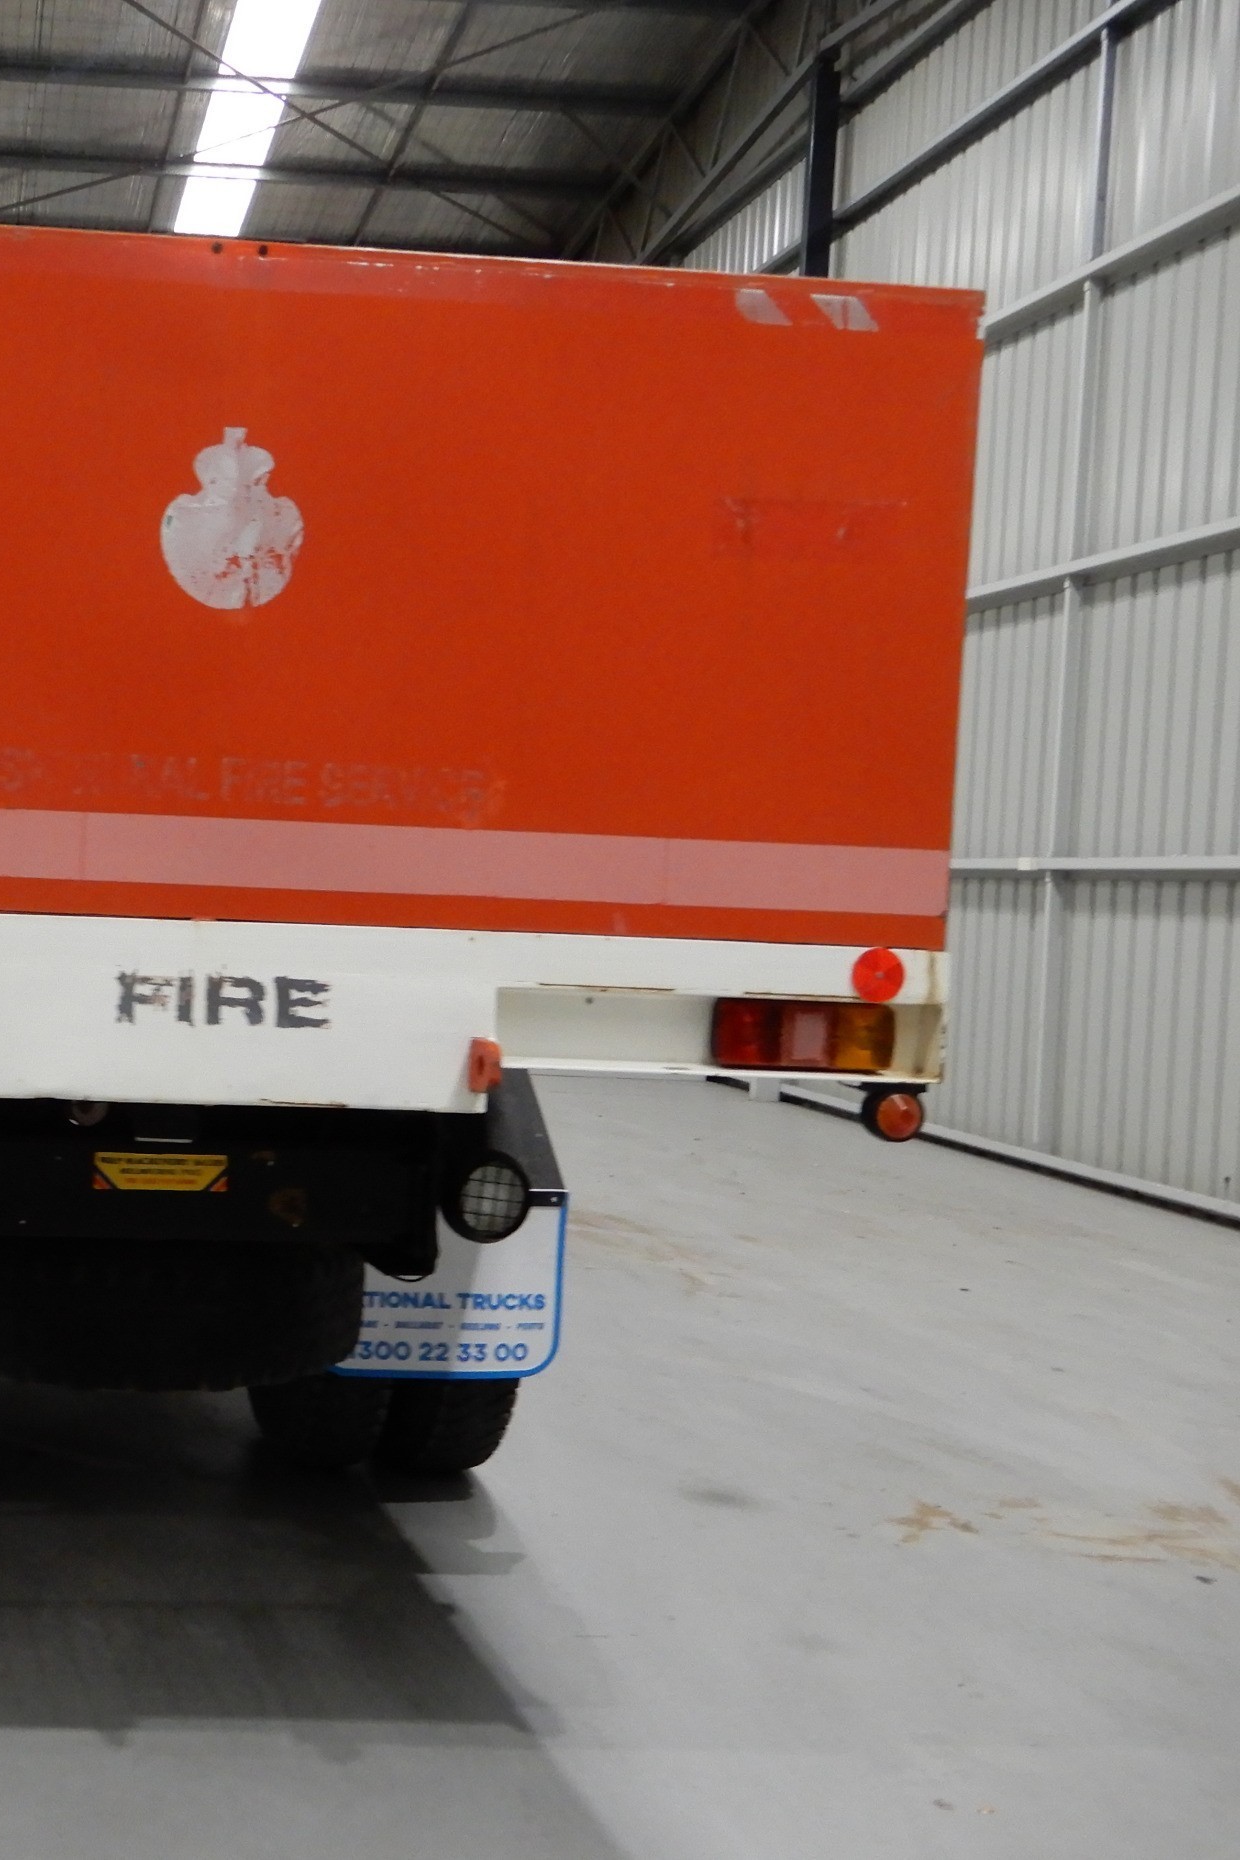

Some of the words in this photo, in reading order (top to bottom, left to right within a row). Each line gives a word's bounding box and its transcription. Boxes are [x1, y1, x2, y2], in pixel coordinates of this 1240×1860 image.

[115, 972, 331, 1028] FIRE
[361, 1291, 452, 1309] TIONAL
[456, 1293, 546, 1310] TRUCKS
[419, 1342, 449, 1361] 22
[457, 1343, 488, 1362] 33
[495, 1342, 529, 1362] 00
